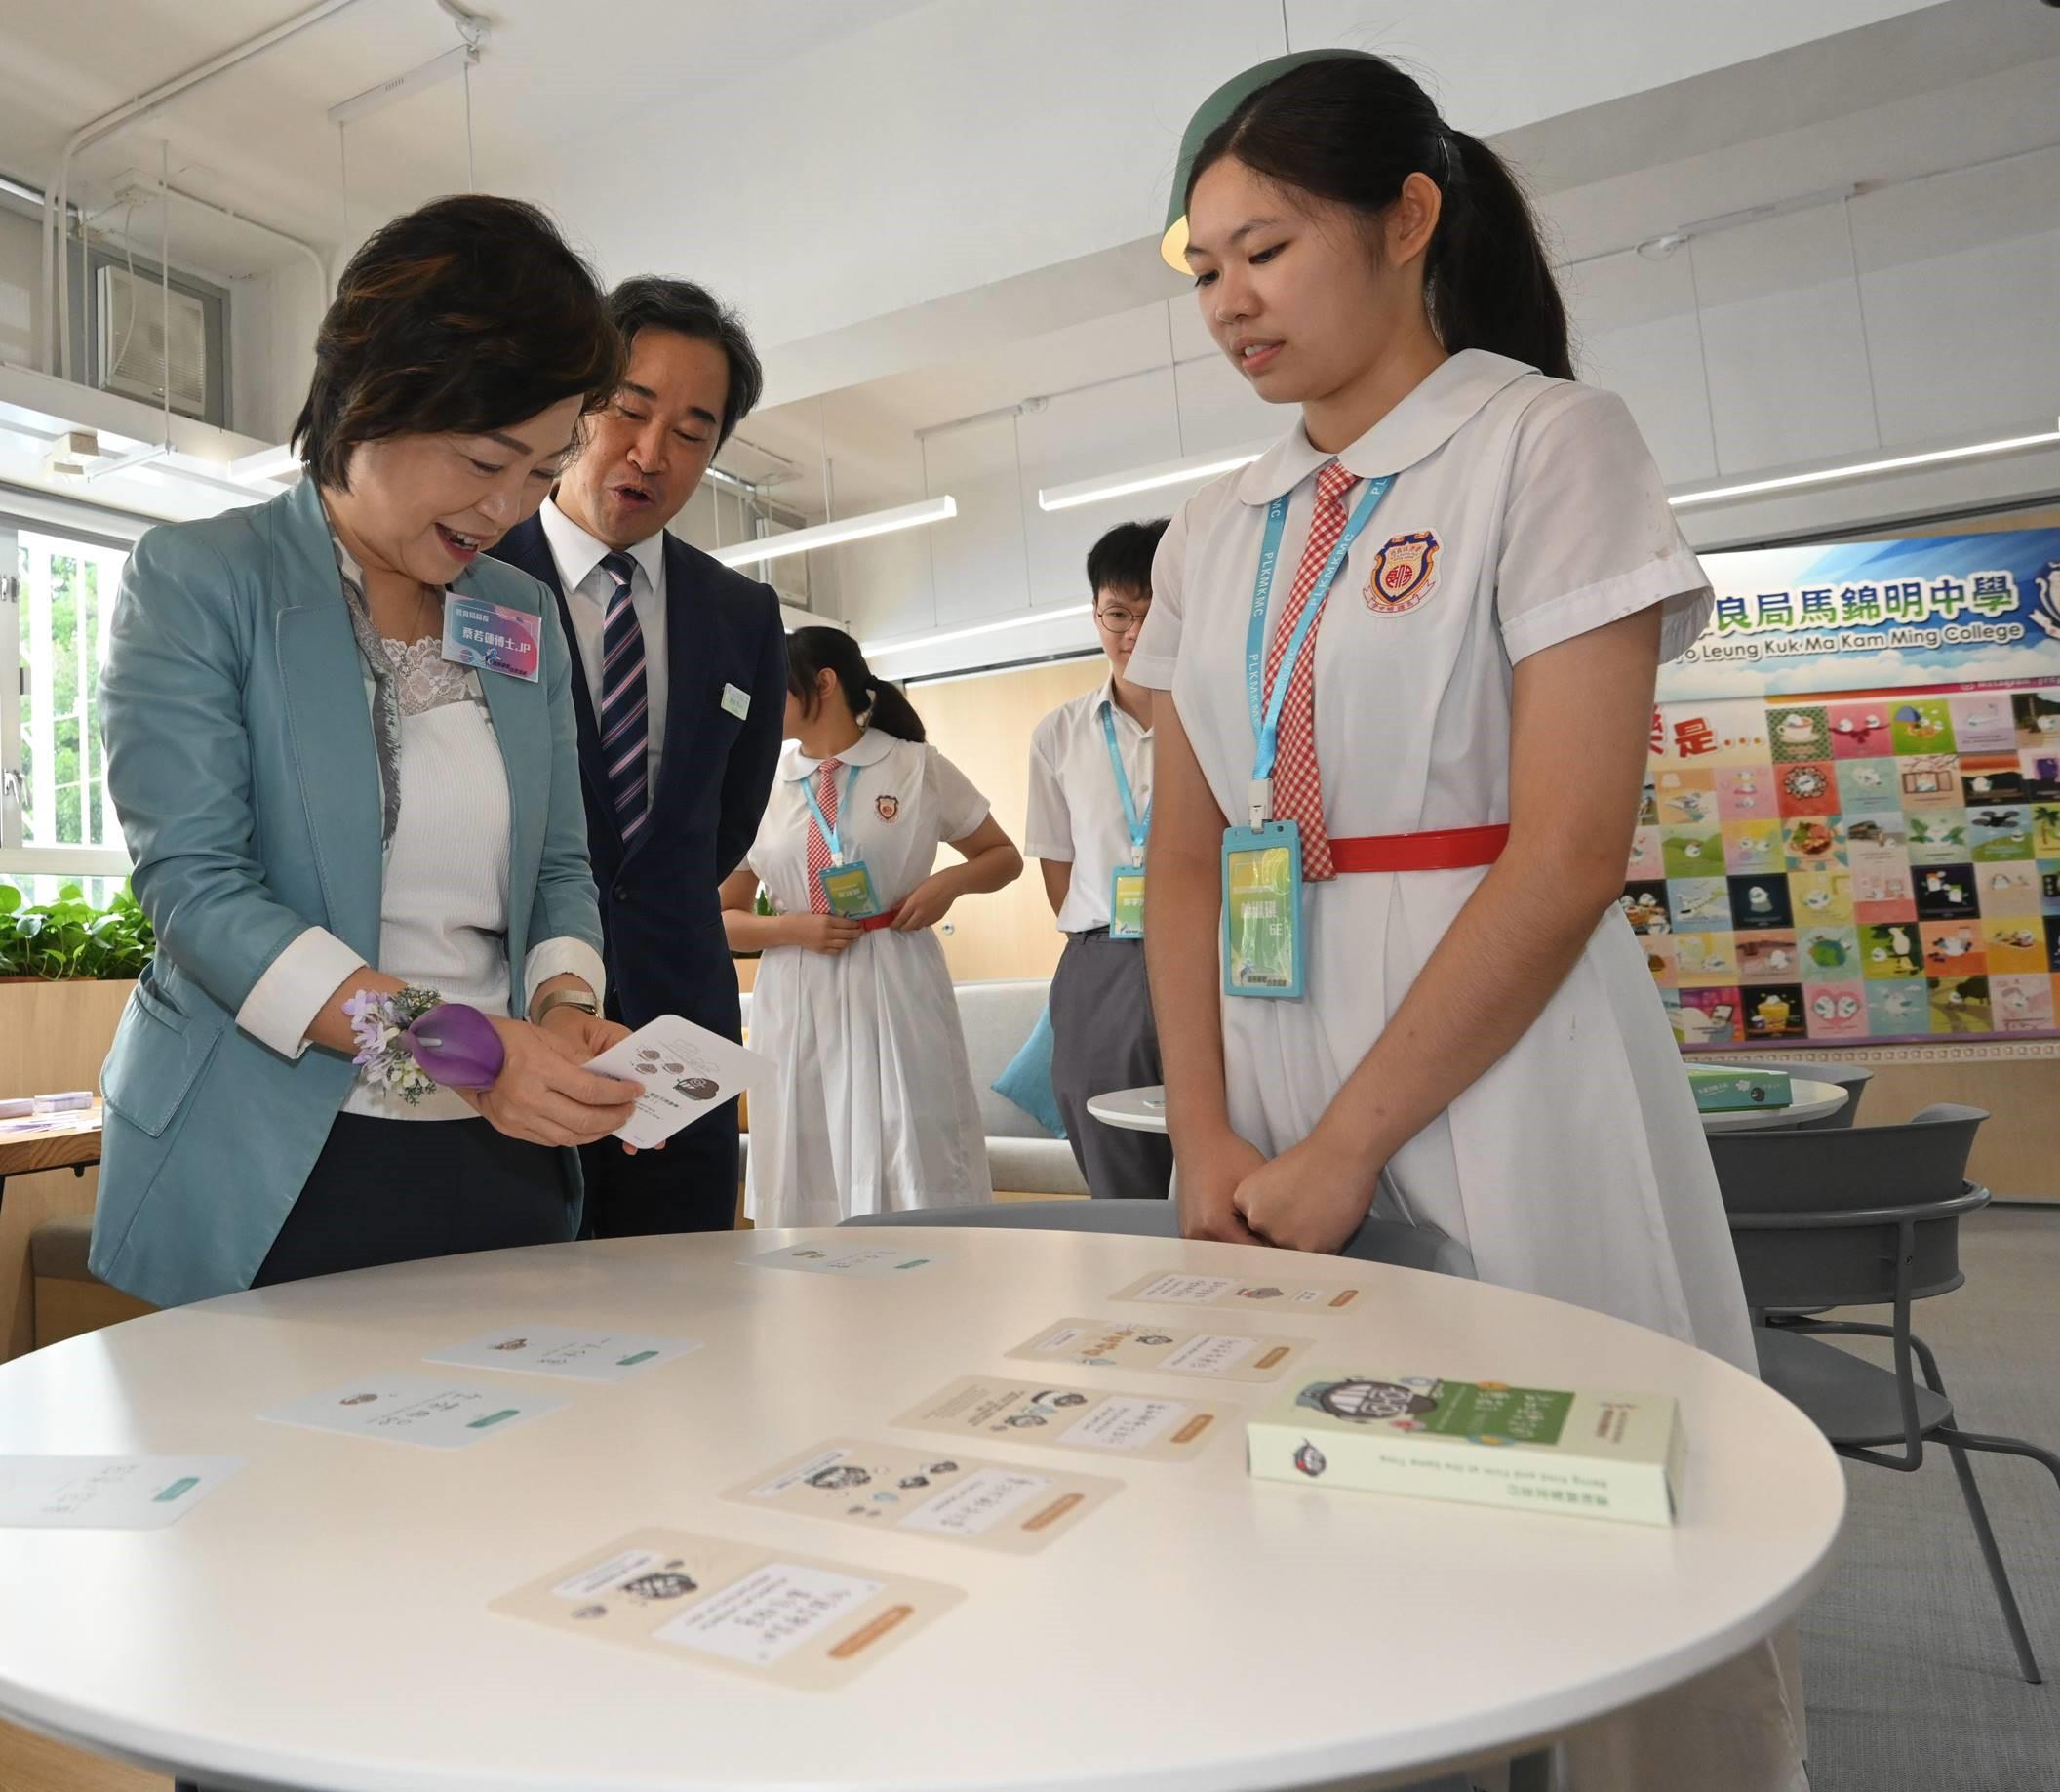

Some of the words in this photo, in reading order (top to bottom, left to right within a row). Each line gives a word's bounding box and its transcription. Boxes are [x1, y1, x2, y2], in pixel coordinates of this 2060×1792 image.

[1254, 552, 1274, 617] PLKMKMC
[1714, 575, 2015, 631] 良局馬錦明中學
[1702, 642, 1759, 660] Leung
[1841, 633, 1885, 649] Kam
[1891, 628, 1938, 648] Ming
[1945, 622, 2023, 644] College
